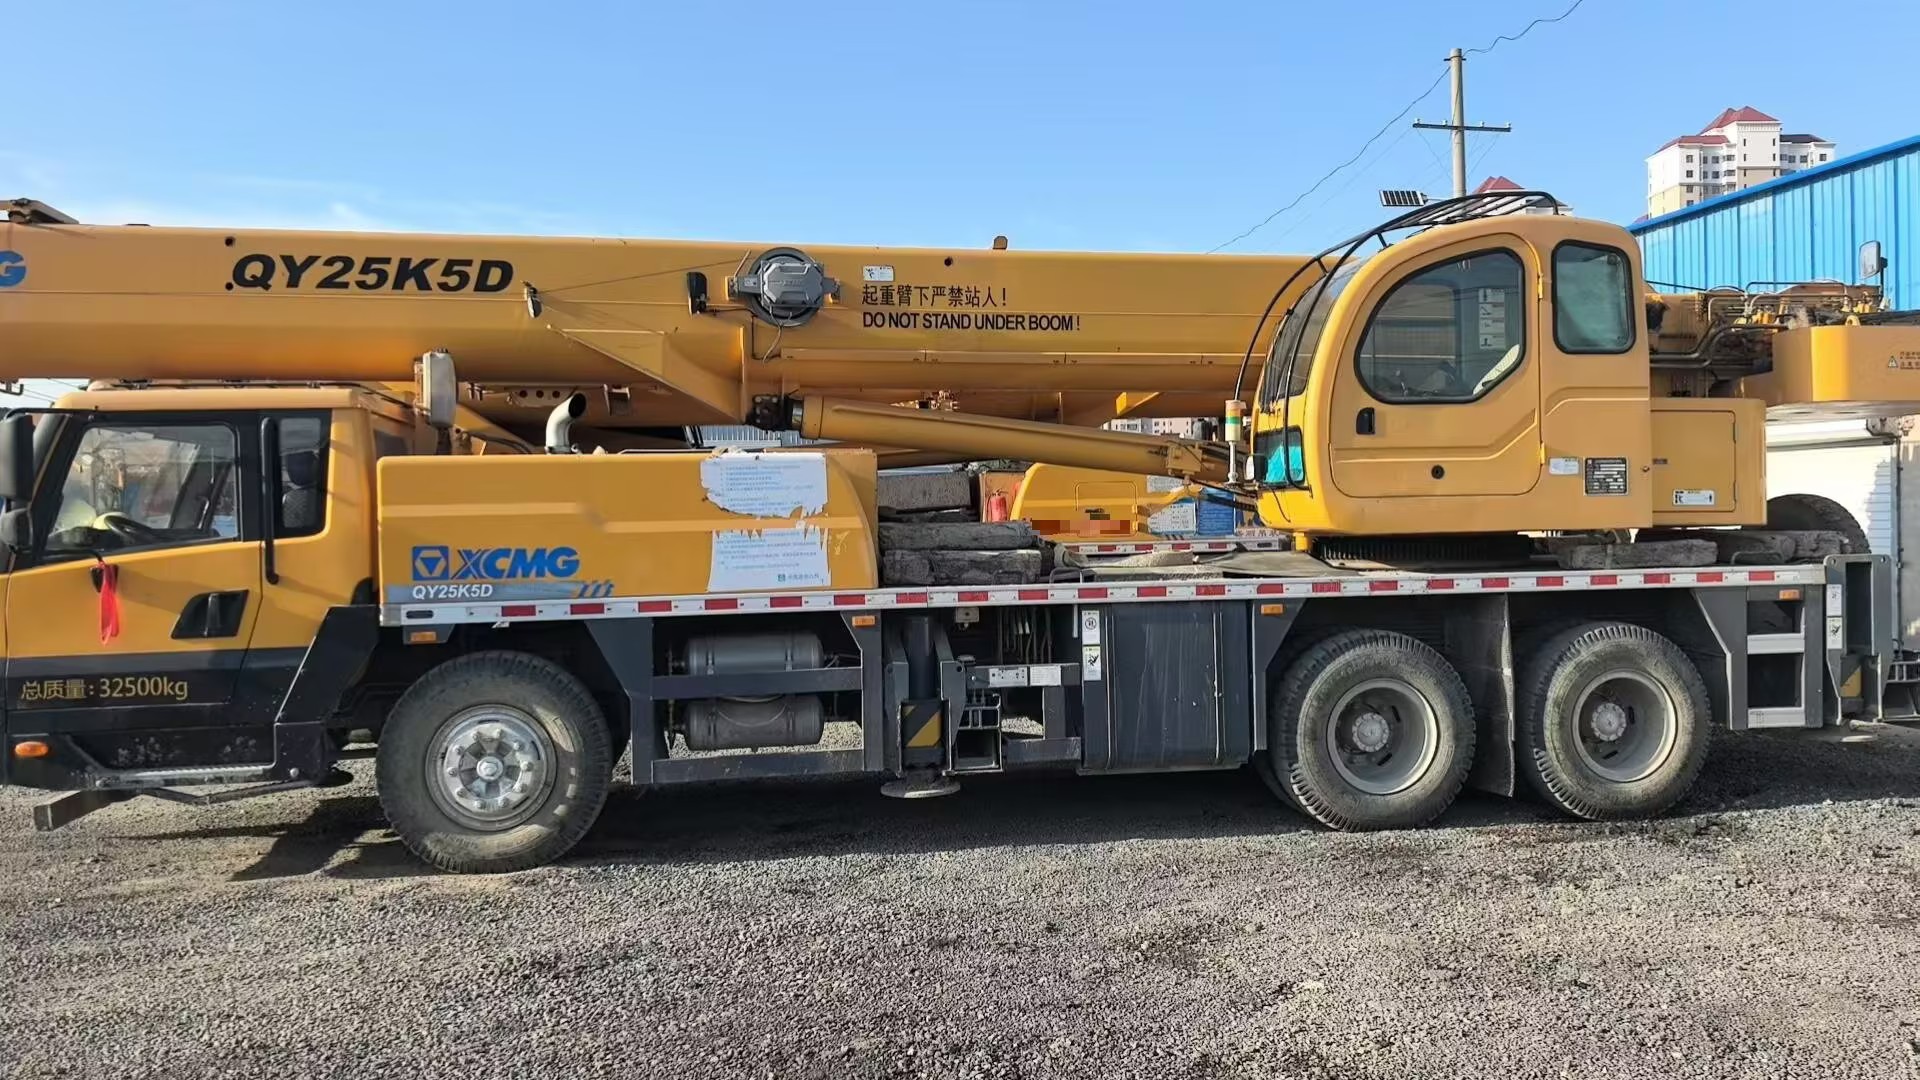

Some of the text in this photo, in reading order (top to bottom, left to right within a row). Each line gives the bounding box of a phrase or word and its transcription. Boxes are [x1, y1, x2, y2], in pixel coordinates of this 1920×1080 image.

[232, 254, 514, 292] QY25K5D
[861, 284, 1007, 308] 起重臂下严禁站人！
[863, 312, 886, 328] DO
[888, 312, 920, 329] NOT
[922, 313, 971, 330] STAND
[974, 314, 1026, 330] UNDER
[451, 547, 580, 580] XCMG
[412, 584, 493, 599] QY25K5D
